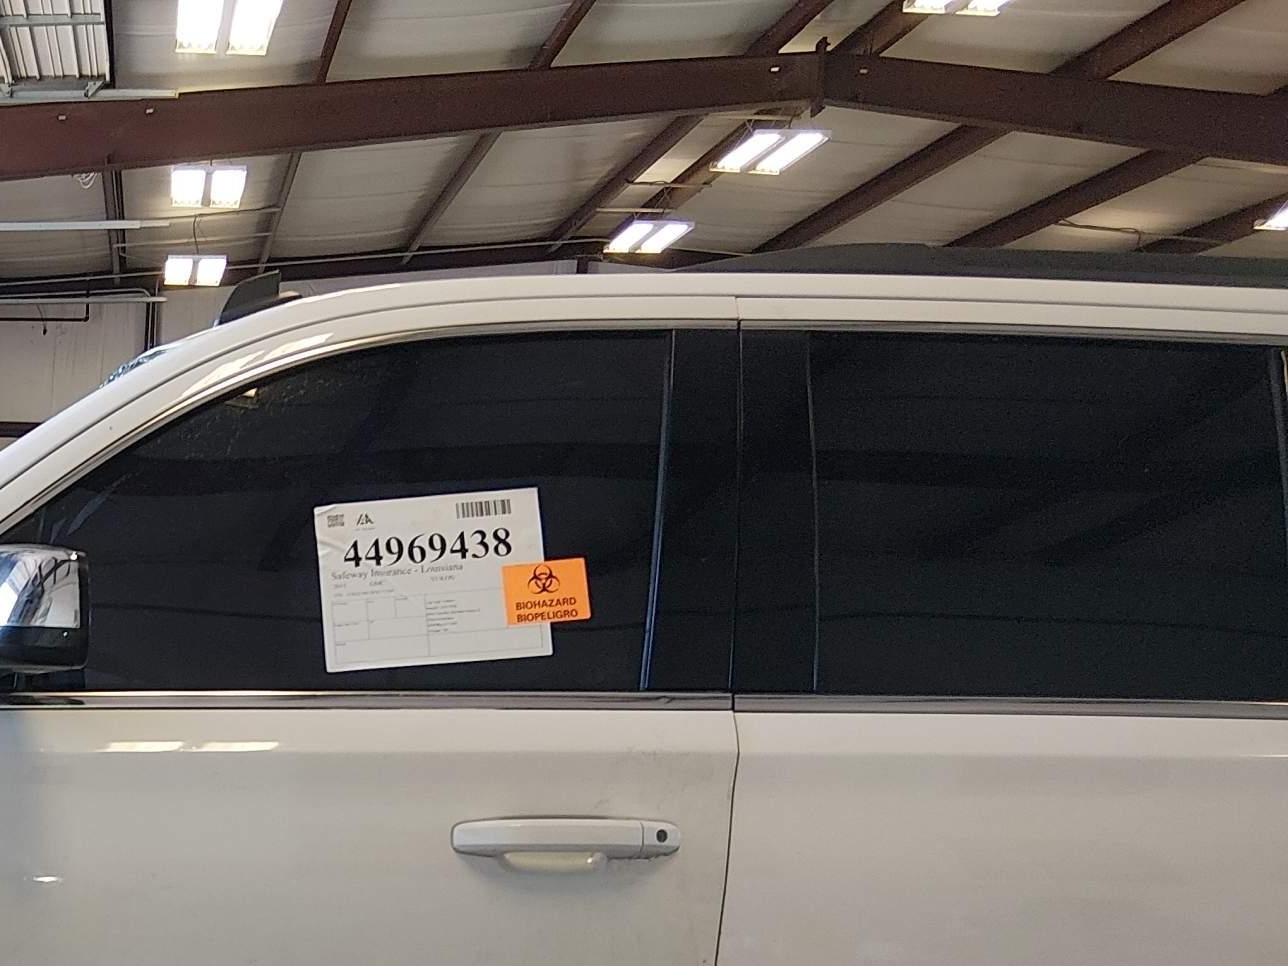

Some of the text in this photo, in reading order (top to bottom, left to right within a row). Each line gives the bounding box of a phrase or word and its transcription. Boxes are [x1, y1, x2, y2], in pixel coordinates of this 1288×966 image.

[344, 527, 512, 568] 44969438
[516, 597, 577, 611] BIOHAZARD
[517, 609, 578, 623] BIOPELIGRO
